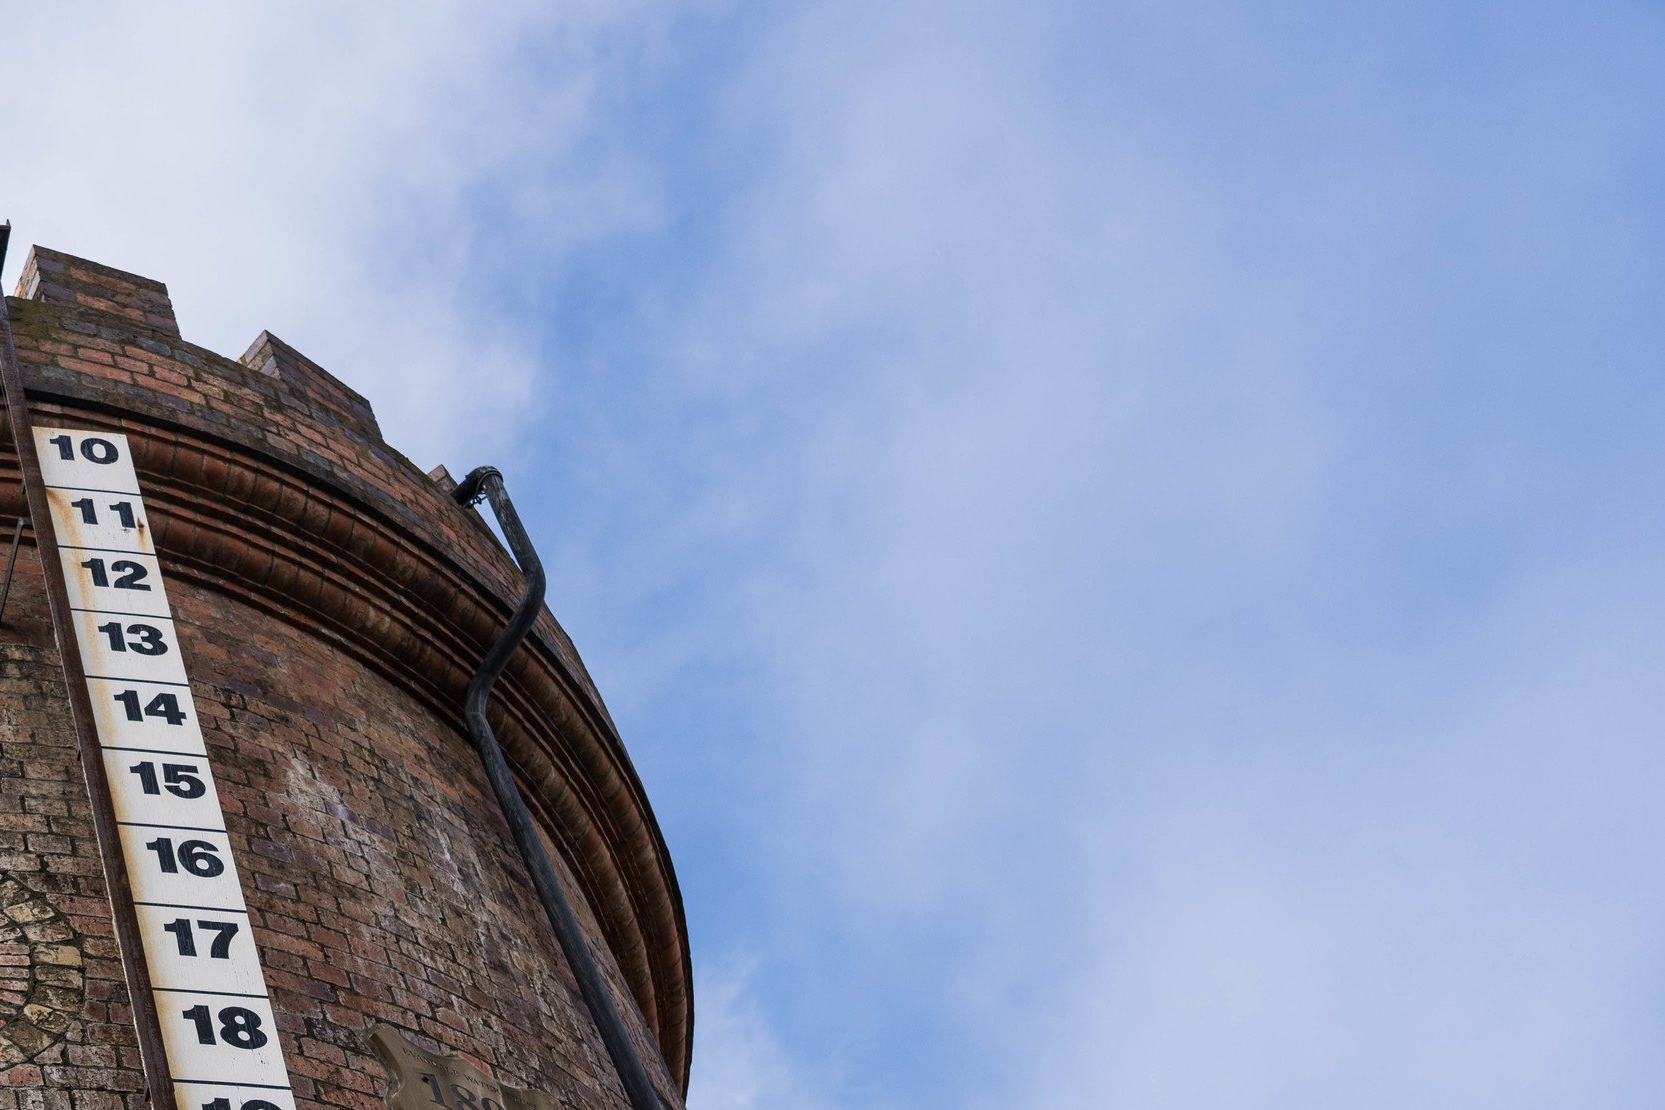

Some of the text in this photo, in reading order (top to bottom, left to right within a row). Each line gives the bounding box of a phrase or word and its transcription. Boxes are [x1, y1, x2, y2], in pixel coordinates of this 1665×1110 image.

[49, 435, 119, 465] 10
[72, 499, 136, 529] 11
[81, 559, 151, 591] 12
[98, 622, 168, 656] 13
[114, 690, 186, 725] 14
[130, 762, 206, 799] 15
[146, 838, 225, 878] 16
[164, 919, 239, 959] 17
[183, 1005, 268, 1049] 18
